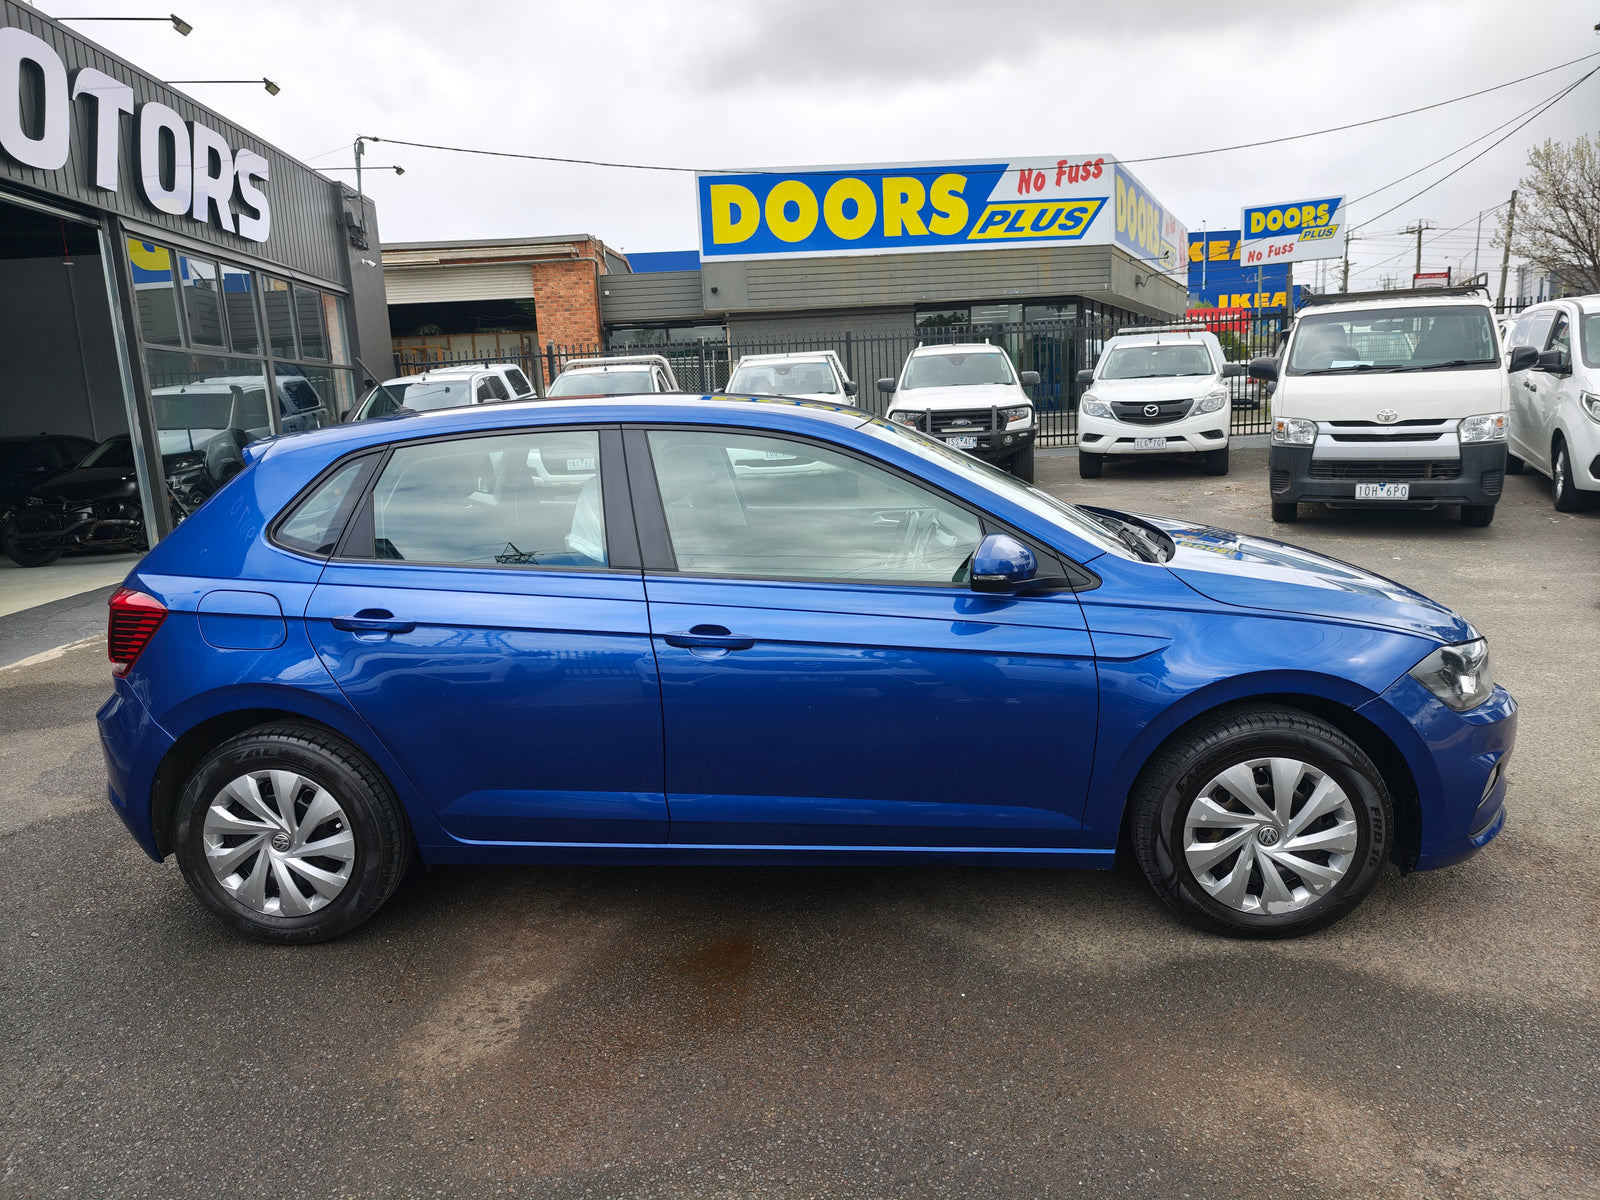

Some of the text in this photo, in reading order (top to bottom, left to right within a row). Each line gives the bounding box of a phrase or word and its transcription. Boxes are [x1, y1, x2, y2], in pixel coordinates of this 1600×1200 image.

[0, 26, 270, 243] OTORS
[1018, 157, 1105, 196] No Fuss
[710, 173, 970, 245] DOORS
[977, 206, 1090, 234] PLUS
[1116, 174, 1160, 257] DOORS
[1250, 203, 1331, 234] DOORS
[1302, 226, 1334, 241] PLUS
[1247, 242, 1295, 264] No Fuss
[1218, 291, 1288, 309] IKEA
